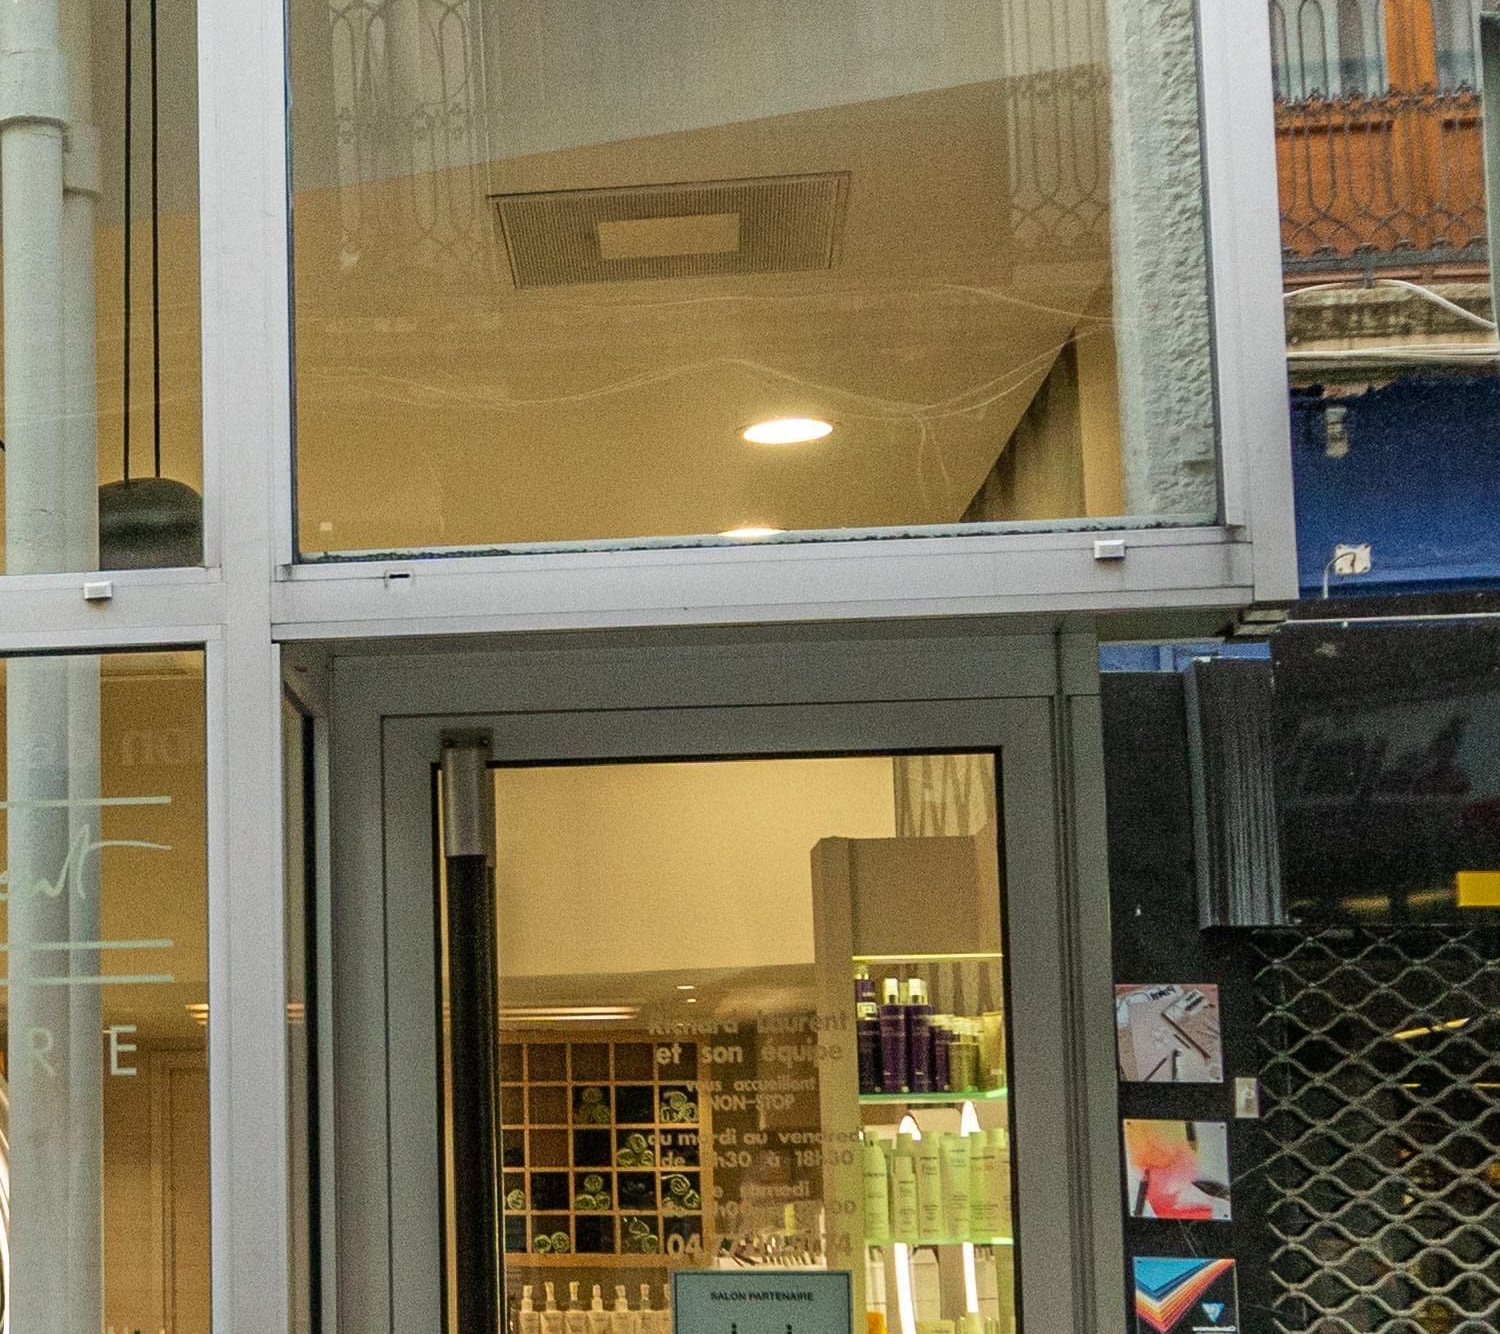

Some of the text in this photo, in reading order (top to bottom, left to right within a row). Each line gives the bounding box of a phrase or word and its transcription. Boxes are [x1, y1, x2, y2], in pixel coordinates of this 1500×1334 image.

[656, 1036, 842, 1069] et son équipe
[709, 1093, 796, 1112] NON-STOP
[743, 1132, 768, 1145] au
[710, 1290, 814, 1303] SALON PARTENAIRE
